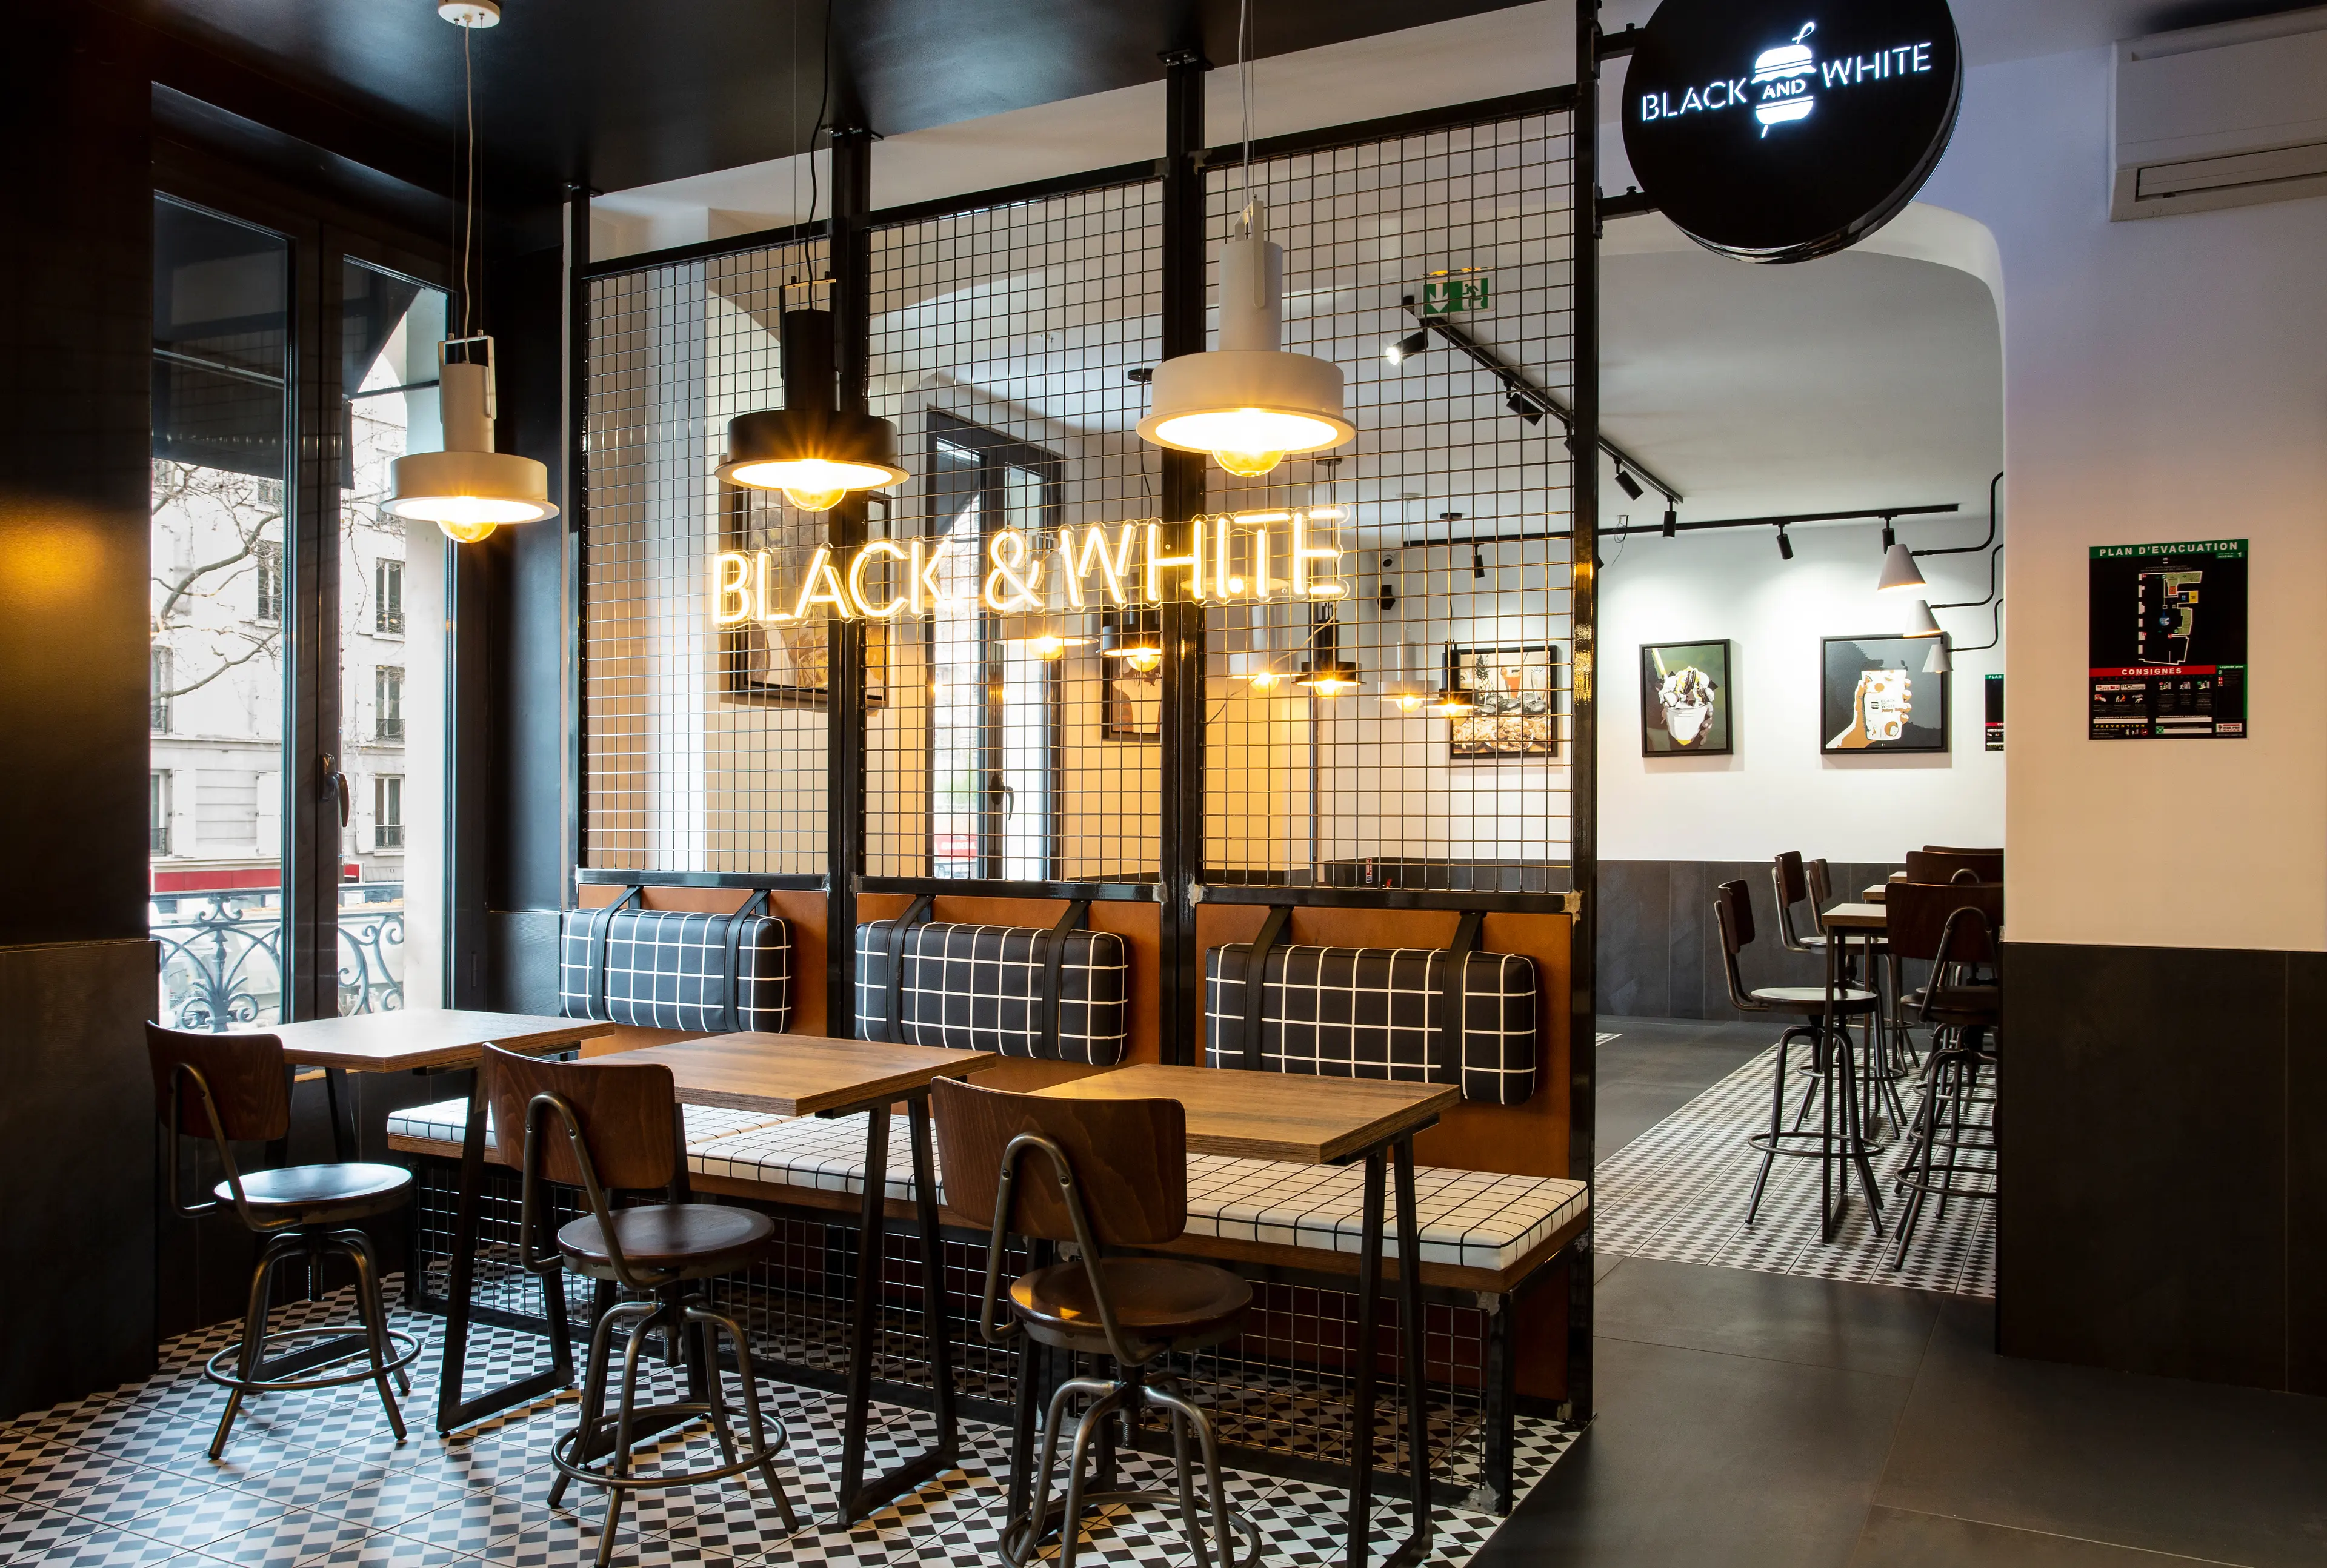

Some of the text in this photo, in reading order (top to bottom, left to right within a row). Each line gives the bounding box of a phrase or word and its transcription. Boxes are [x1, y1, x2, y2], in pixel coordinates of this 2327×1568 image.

[1642, 42, 1932, 121] BLACK AND WHITE
[711, 508, 1342, 625] BLACK & WHITE
[2100, 542, 2238, 557] PLAN D'EVACUATION
